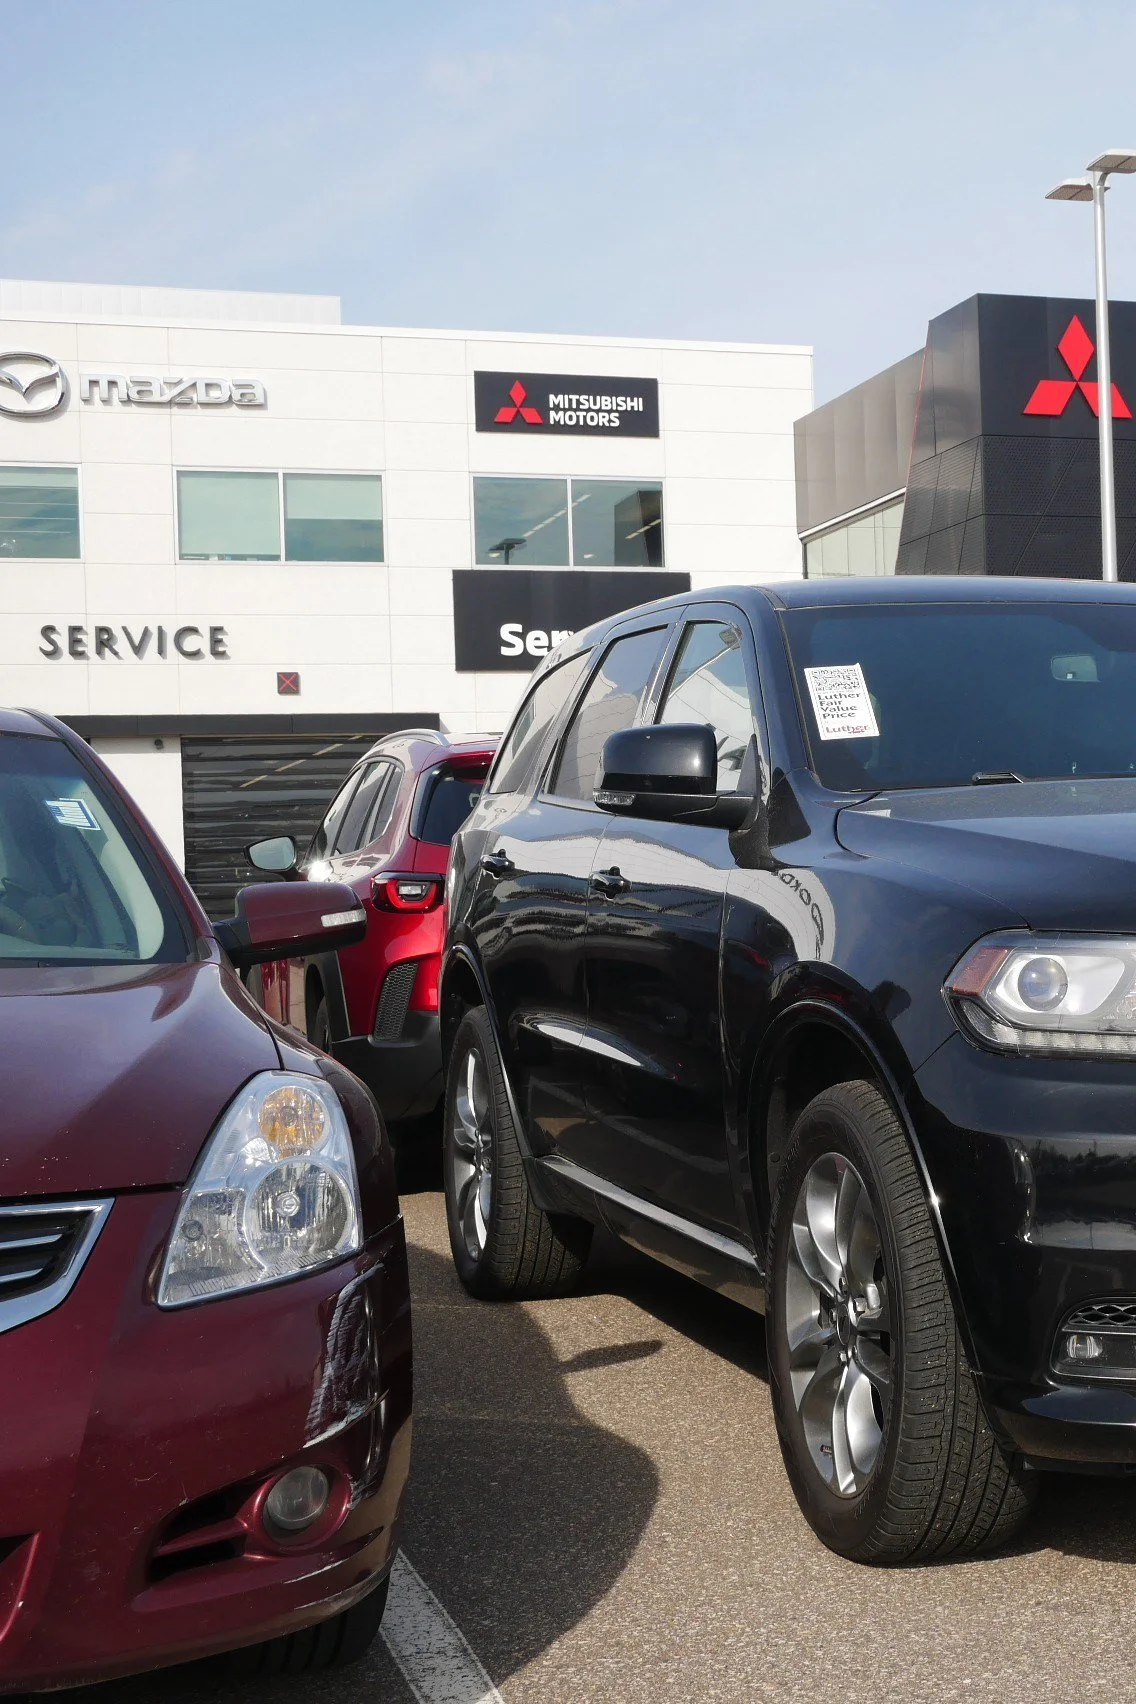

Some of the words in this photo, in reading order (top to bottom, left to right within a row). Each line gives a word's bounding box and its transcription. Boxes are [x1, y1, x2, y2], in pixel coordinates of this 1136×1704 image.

[548, 394, 644, 412] MITSUBISHI
[549, 410, 620, 427] MOTORS
[39, 624, 228, 657] SERVICE
[500, 622, 574, 657] Ser
[817, 692, 861, 701] Luther
[822, 711, 856, 719] Price
